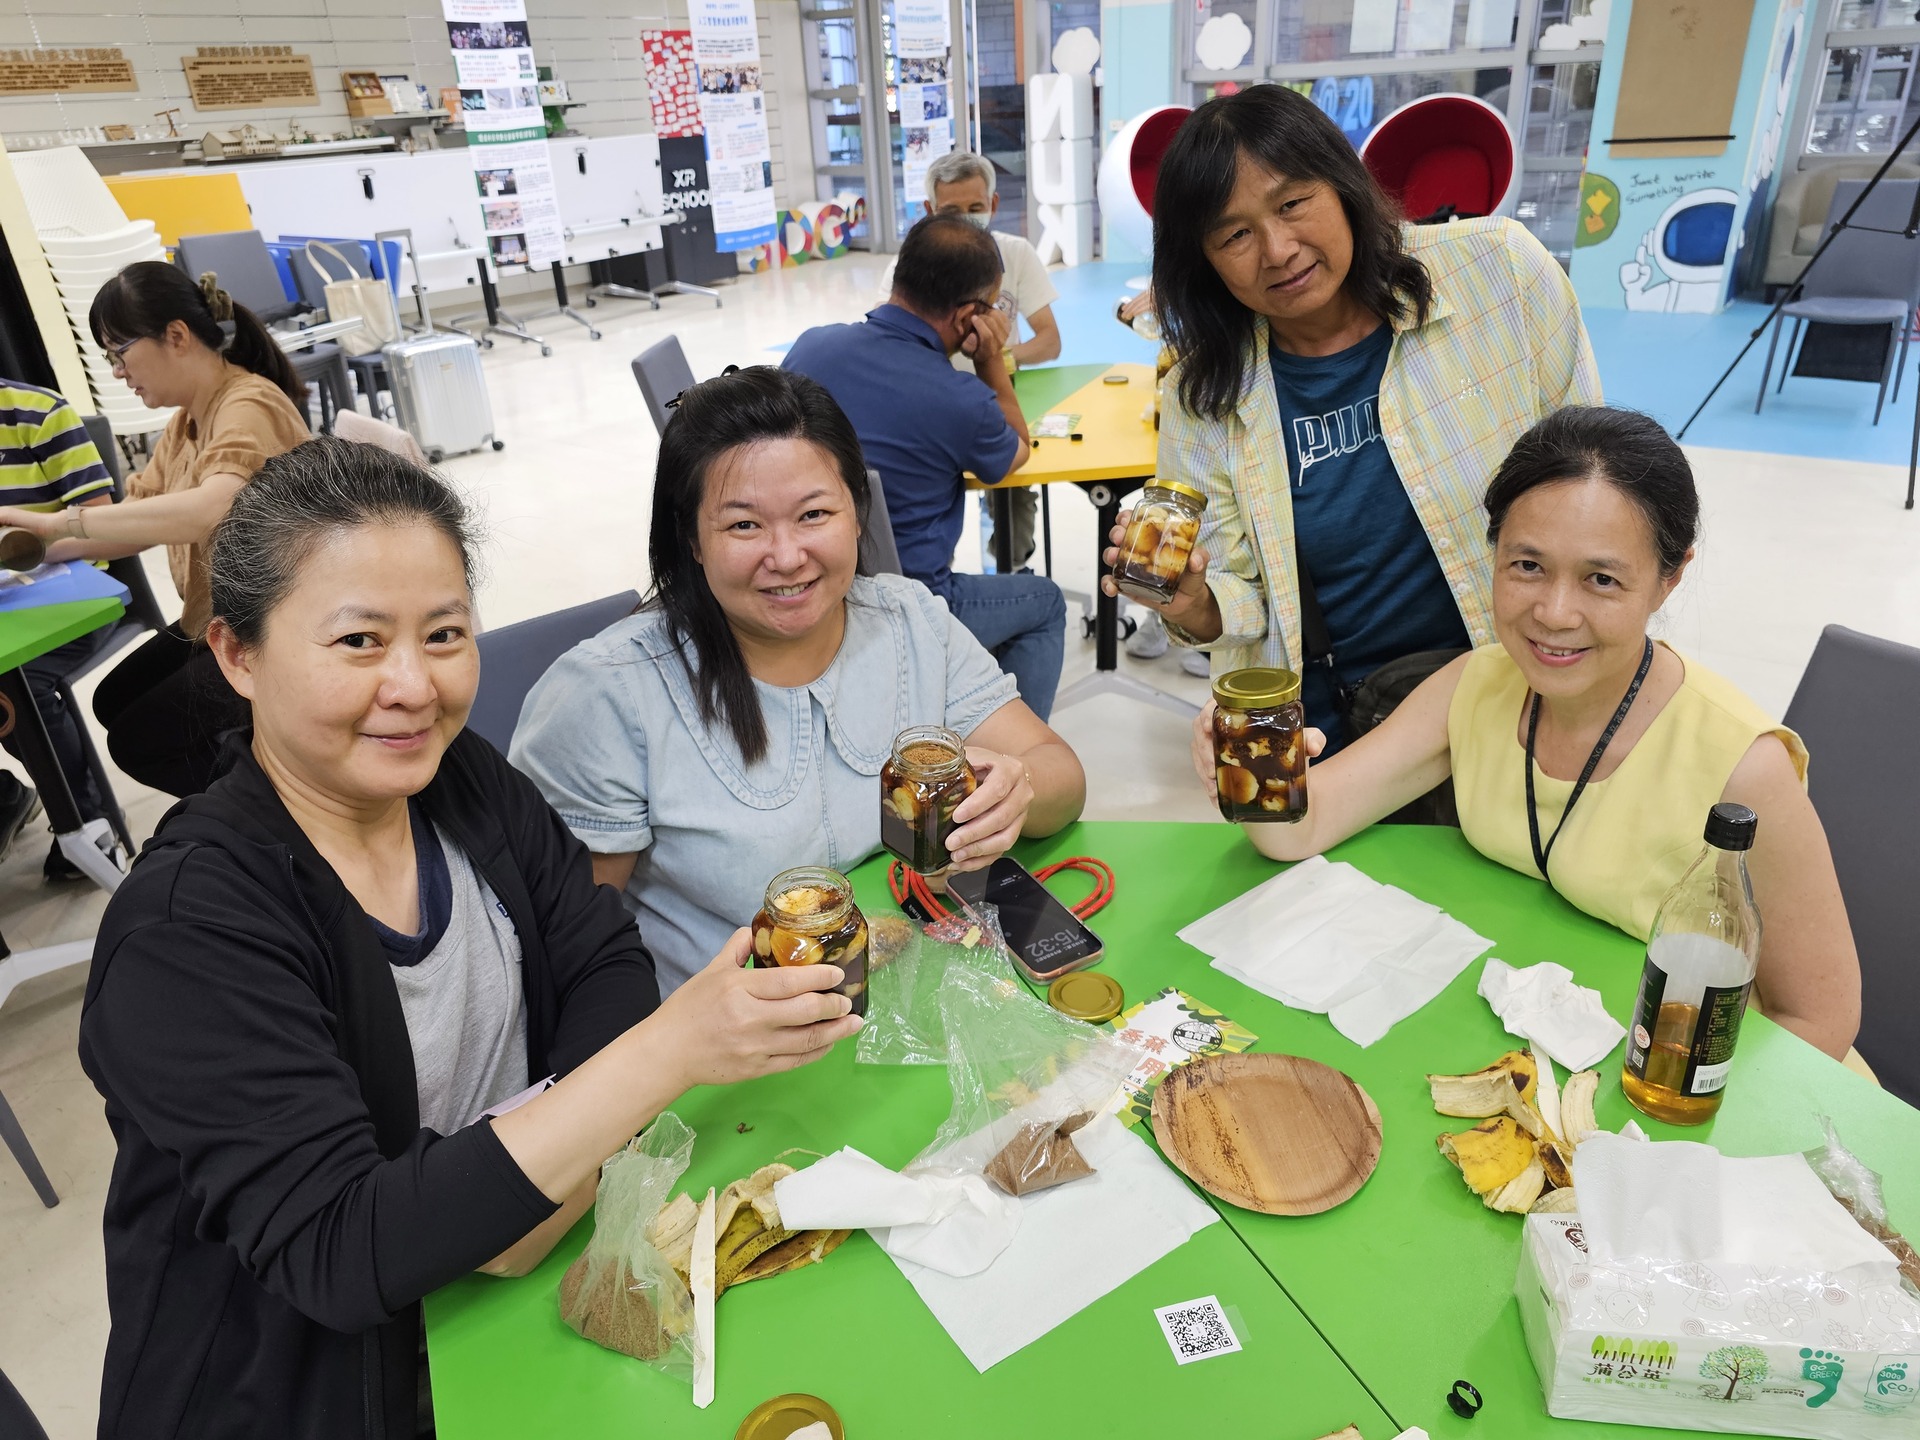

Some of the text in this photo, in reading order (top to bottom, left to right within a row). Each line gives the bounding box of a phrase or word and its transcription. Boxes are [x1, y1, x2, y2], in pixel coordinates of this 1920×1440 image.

[672, 168, 696, 188] XR
[1674, 170, 1715, 183] write
[1025, 929, 1080, 957] 15:32
[1587, 1363, 1664, 1382] 蒲公英
[1810, 1364, 1827, 1372] GO
[1809, 1370, 1840, 1380] GREEN
[1880, 1370, 1902, 1381] 300g
